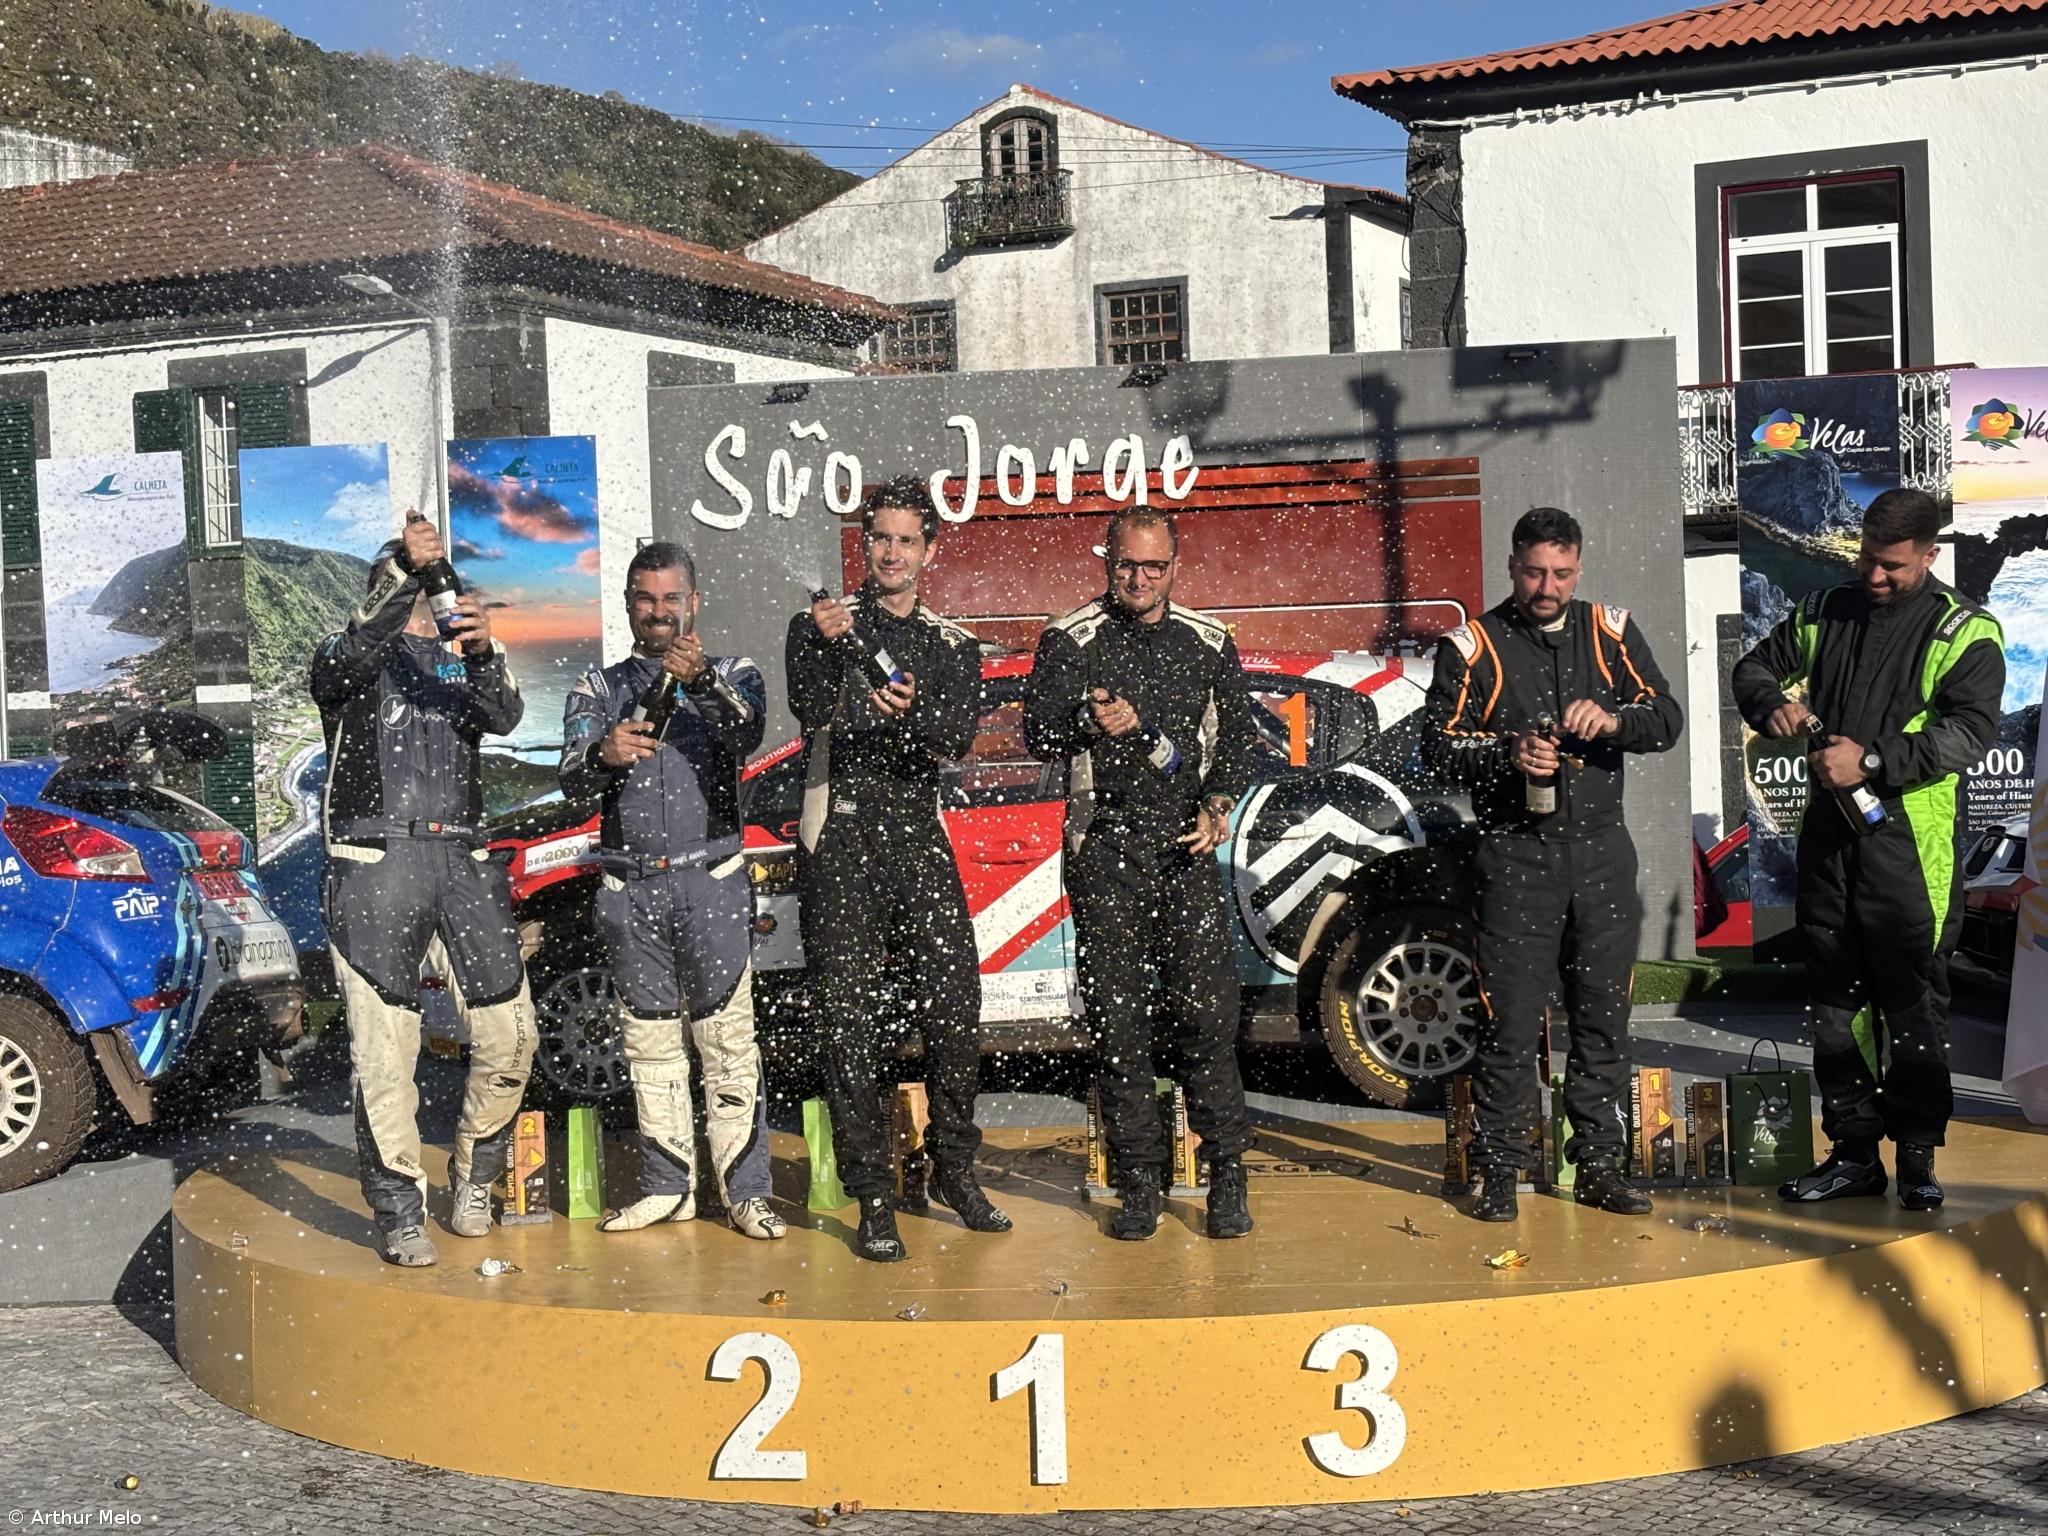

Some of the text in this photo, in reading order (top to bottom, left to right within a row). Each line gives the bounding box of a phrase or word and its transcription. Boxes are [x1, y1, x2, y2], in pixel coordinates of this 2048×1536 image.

[1810, 418, 1866, 454] Velas
[134, 480, 167, 491] CALHETA
[691, 415, 1199, 530] São Jorge
[1073, 624, 1091, 640] OMP
[1204, 629, 1223, 643] OMP
[1279, 692, 1307, 767] 1
[1967, 779, 2002, 790] ANOS
[1967, 792, 1995, 801] Years
[1996, 791, 2008, 800] of
[1337, 1000, 1413, 1090] SCORPION
[523, 1117, 535, 1133] 2
[1176, 1113, 1184, 1138] QUEIJO
[1632, 1103, 1641, 1128] QUEIJO
[1089, 1140, 1097, 1169] CAPITAL
[1177, 1140, 1185, 1169] CAPITAL
[707, 1331, 808, 1481] 2
[994, 1333, 1069, 1485] 1
[1305, 1324, 1407, 1477] 3
